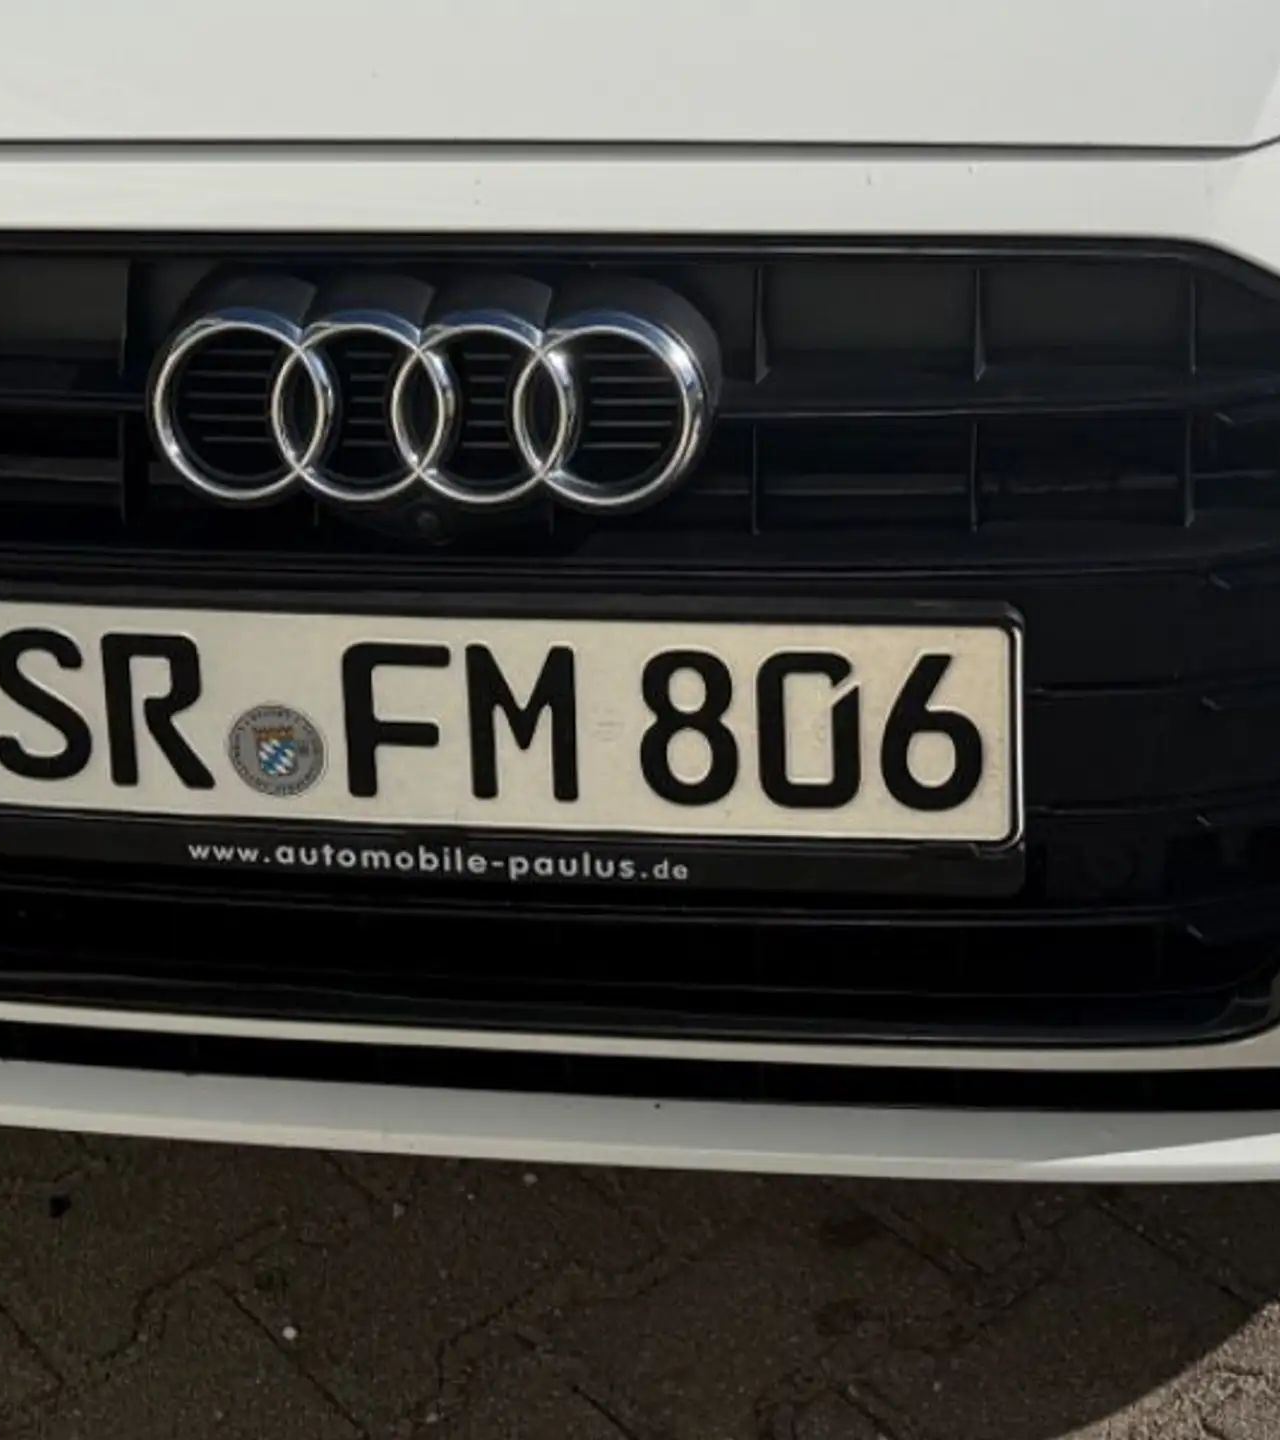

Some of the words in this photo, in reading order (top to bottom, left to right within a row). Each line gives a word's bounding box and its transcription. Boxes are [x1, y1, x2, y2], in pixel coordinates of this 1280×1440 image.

[340, 641, 580, 804] FM
[638, 649, 985, 813] 806
[187, 843, 689, 881] www.automobile-paulus.de
